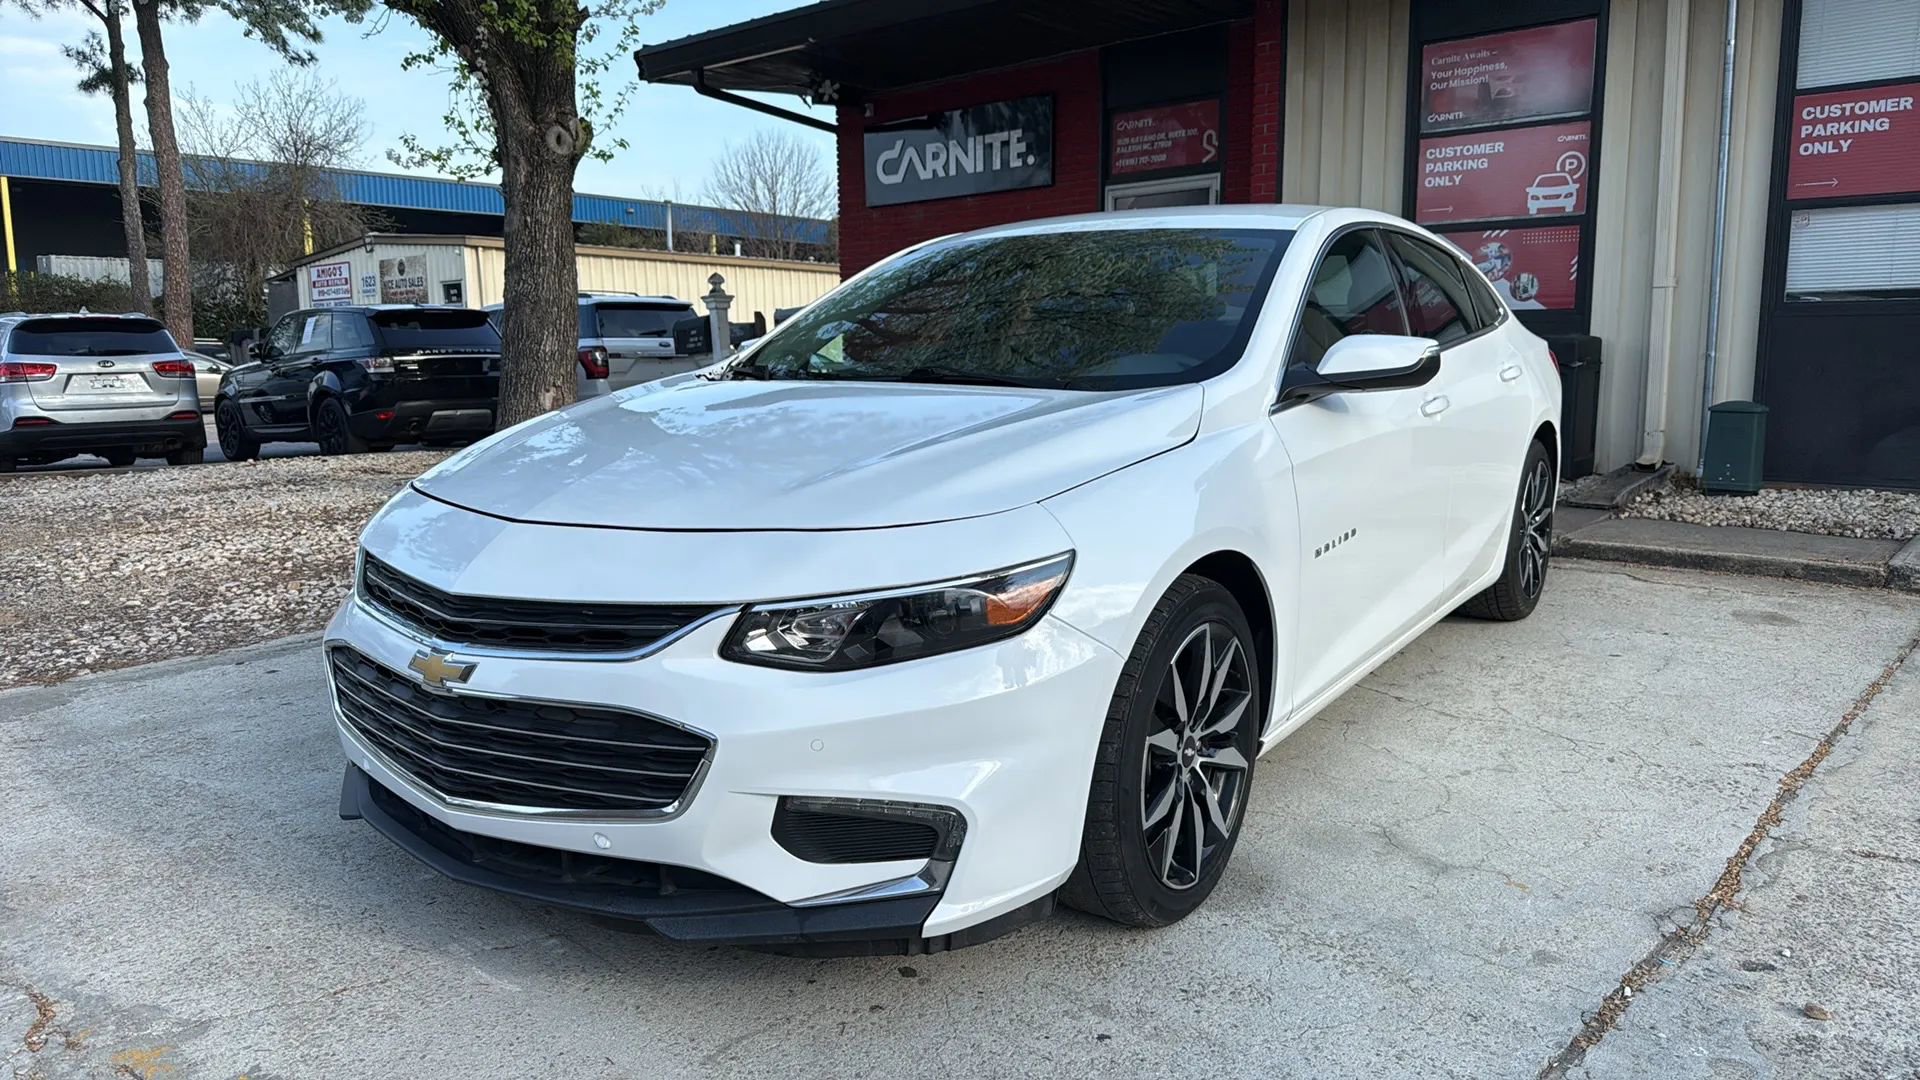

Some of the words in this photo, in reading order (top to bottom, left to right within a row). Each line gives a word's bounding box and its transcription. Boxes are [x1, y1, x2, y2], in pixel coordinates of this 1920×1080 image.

[1432, 55, 1460, 65] Carnite
[1463, 50, 1490, 60] Awaits
[1431, 70, 1452, 79] Your
[1454, 62, 1508, 76] Happiness,
[1430, 82, 1448, 90] Our
[1449, 75, 1488, 88] Mission!
[1802, 97, 1914, 120] CUSTOMER
[1800, 118, 1890, 138] PARKING
[1426, 142, 1504, 159] CUSTOMER
[1799, 139, 1853, 155] ONLY
[1425, 158, 1488, 173] PARKING
[1424, 175, 1462, 187] ONLY
[317, 266, 343, 278] AMIGO'S
[361, 275, 376, 288] 1623
[395, 278, 407, 289] AUTO
[408, 276, 424, 288] SALES
